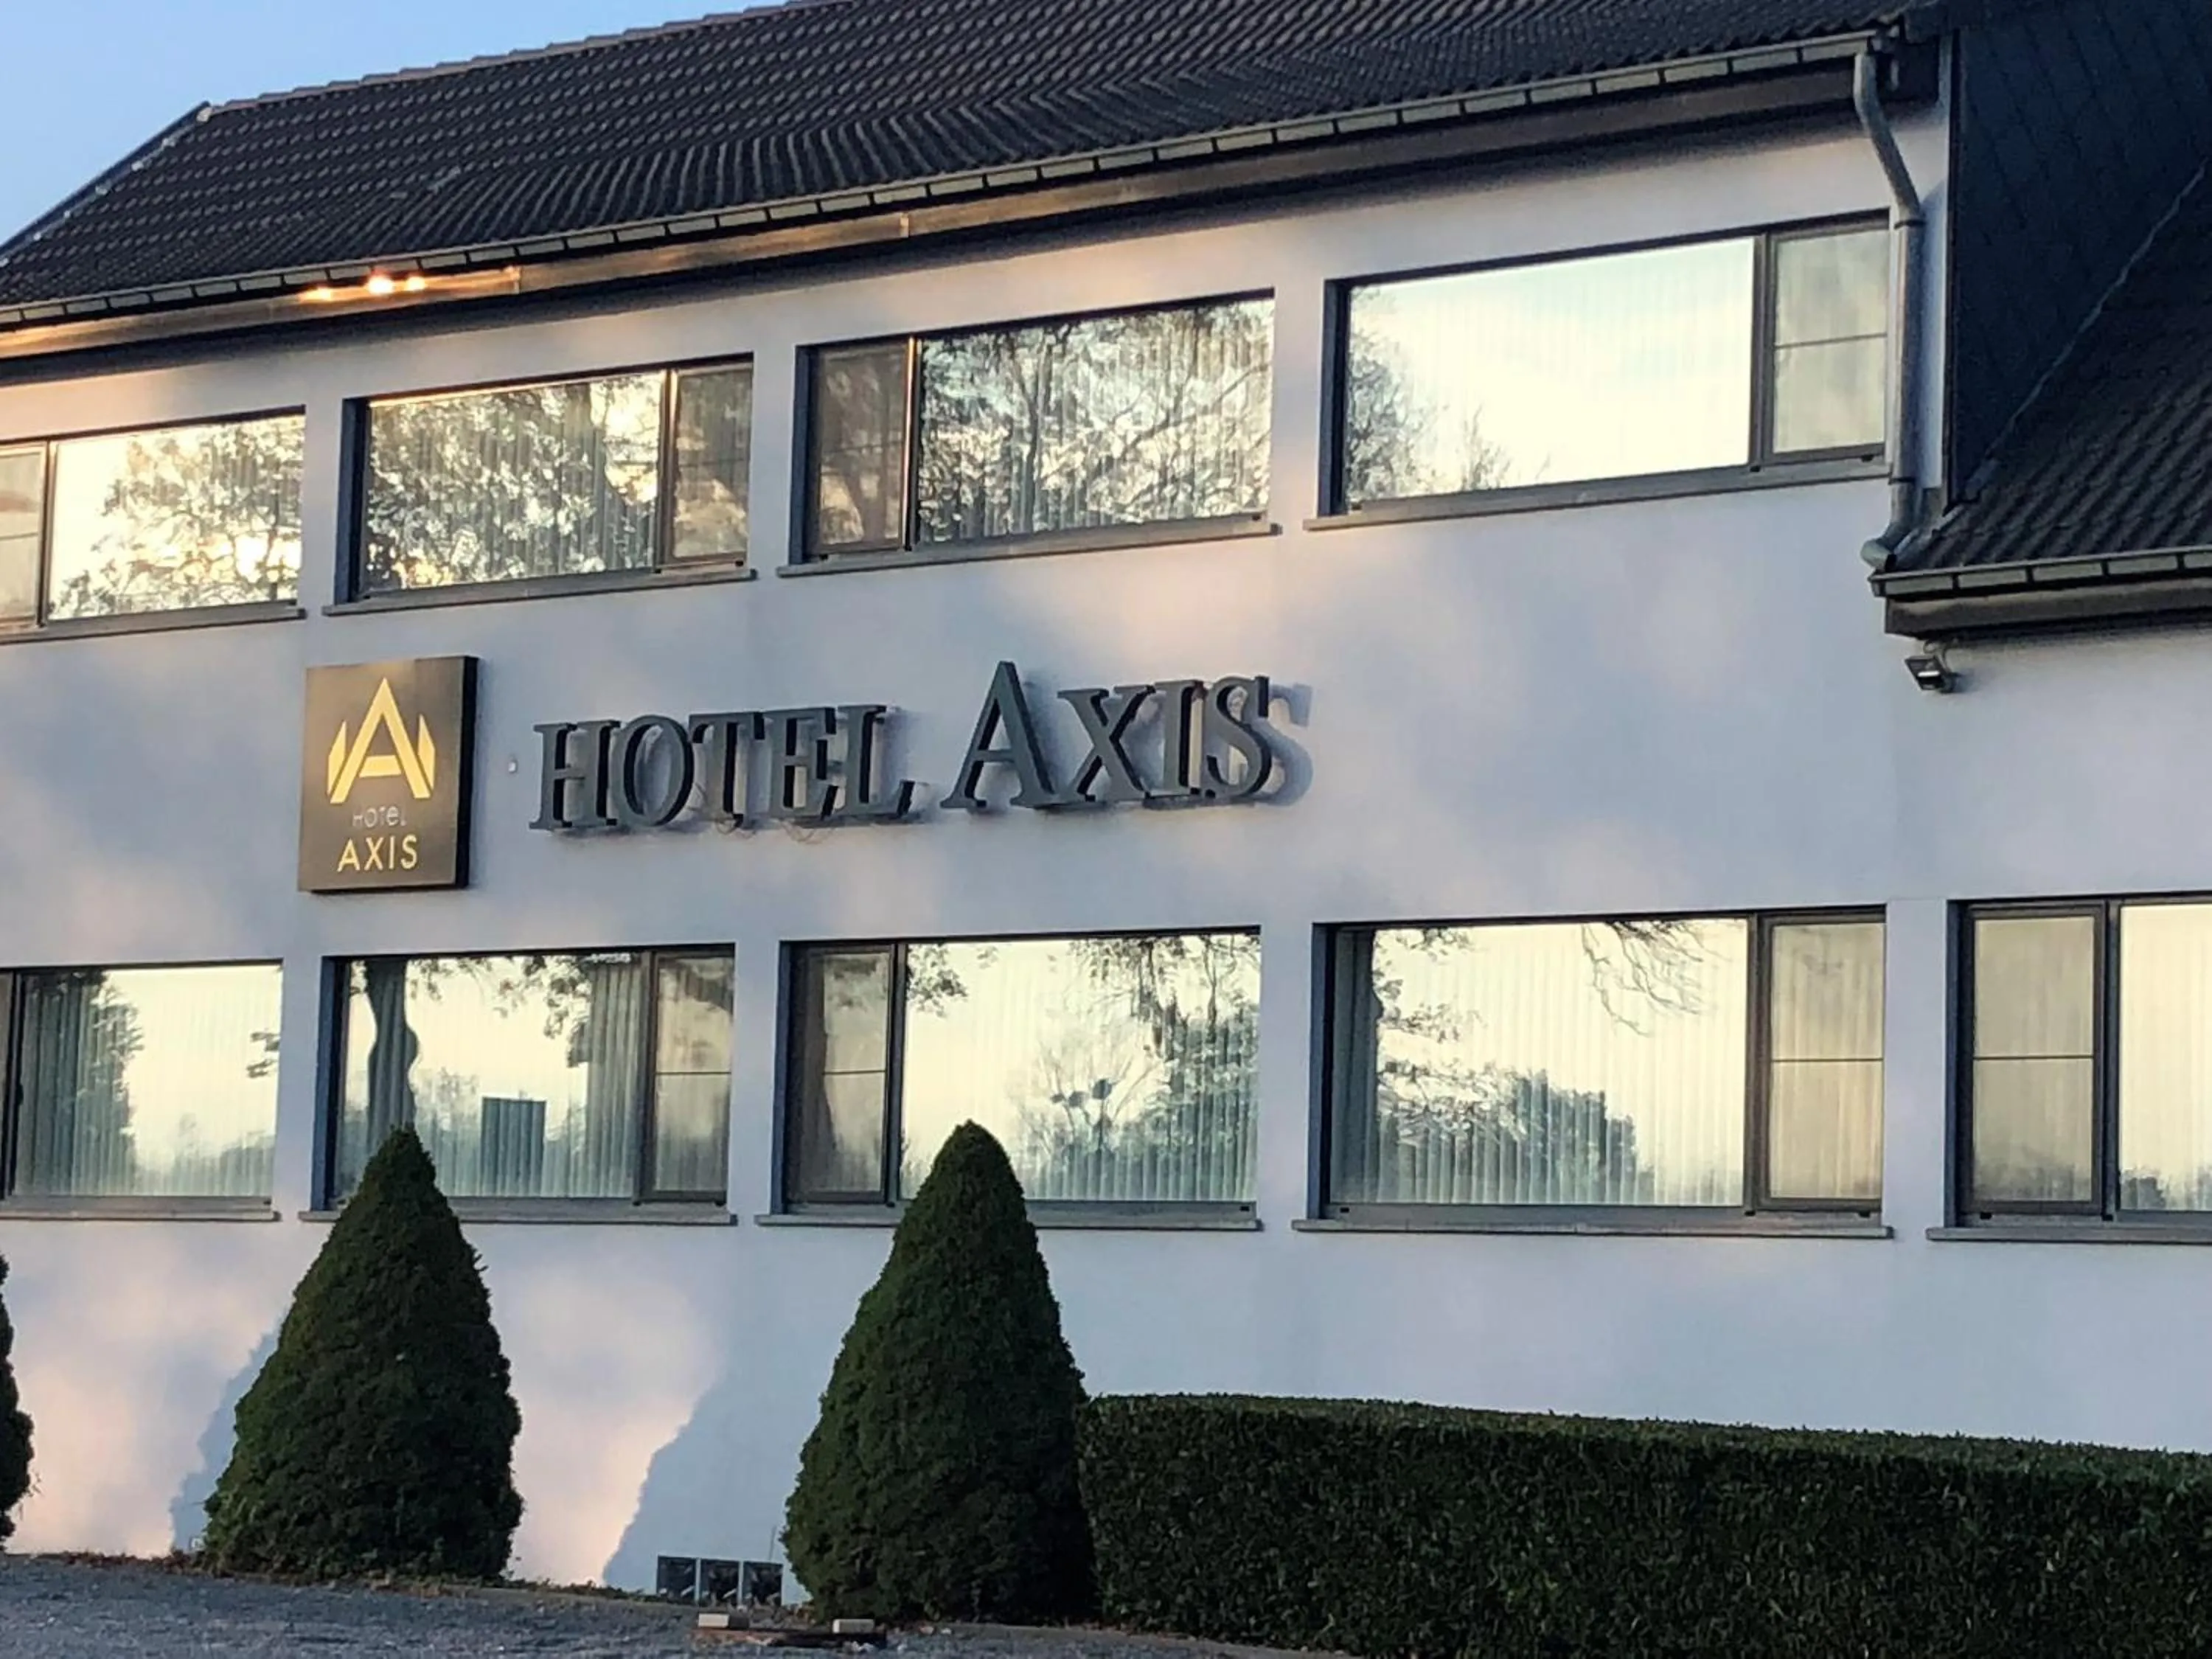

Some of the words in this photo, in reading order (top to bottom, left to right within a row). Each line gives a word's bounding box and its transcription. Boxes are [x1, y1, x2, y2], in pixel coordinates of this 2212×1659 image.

[529, 704, 916, 830] HOTEL
[939, 660, 1270, 809] AXIS
[337, 835, 419, 872] AXIS
